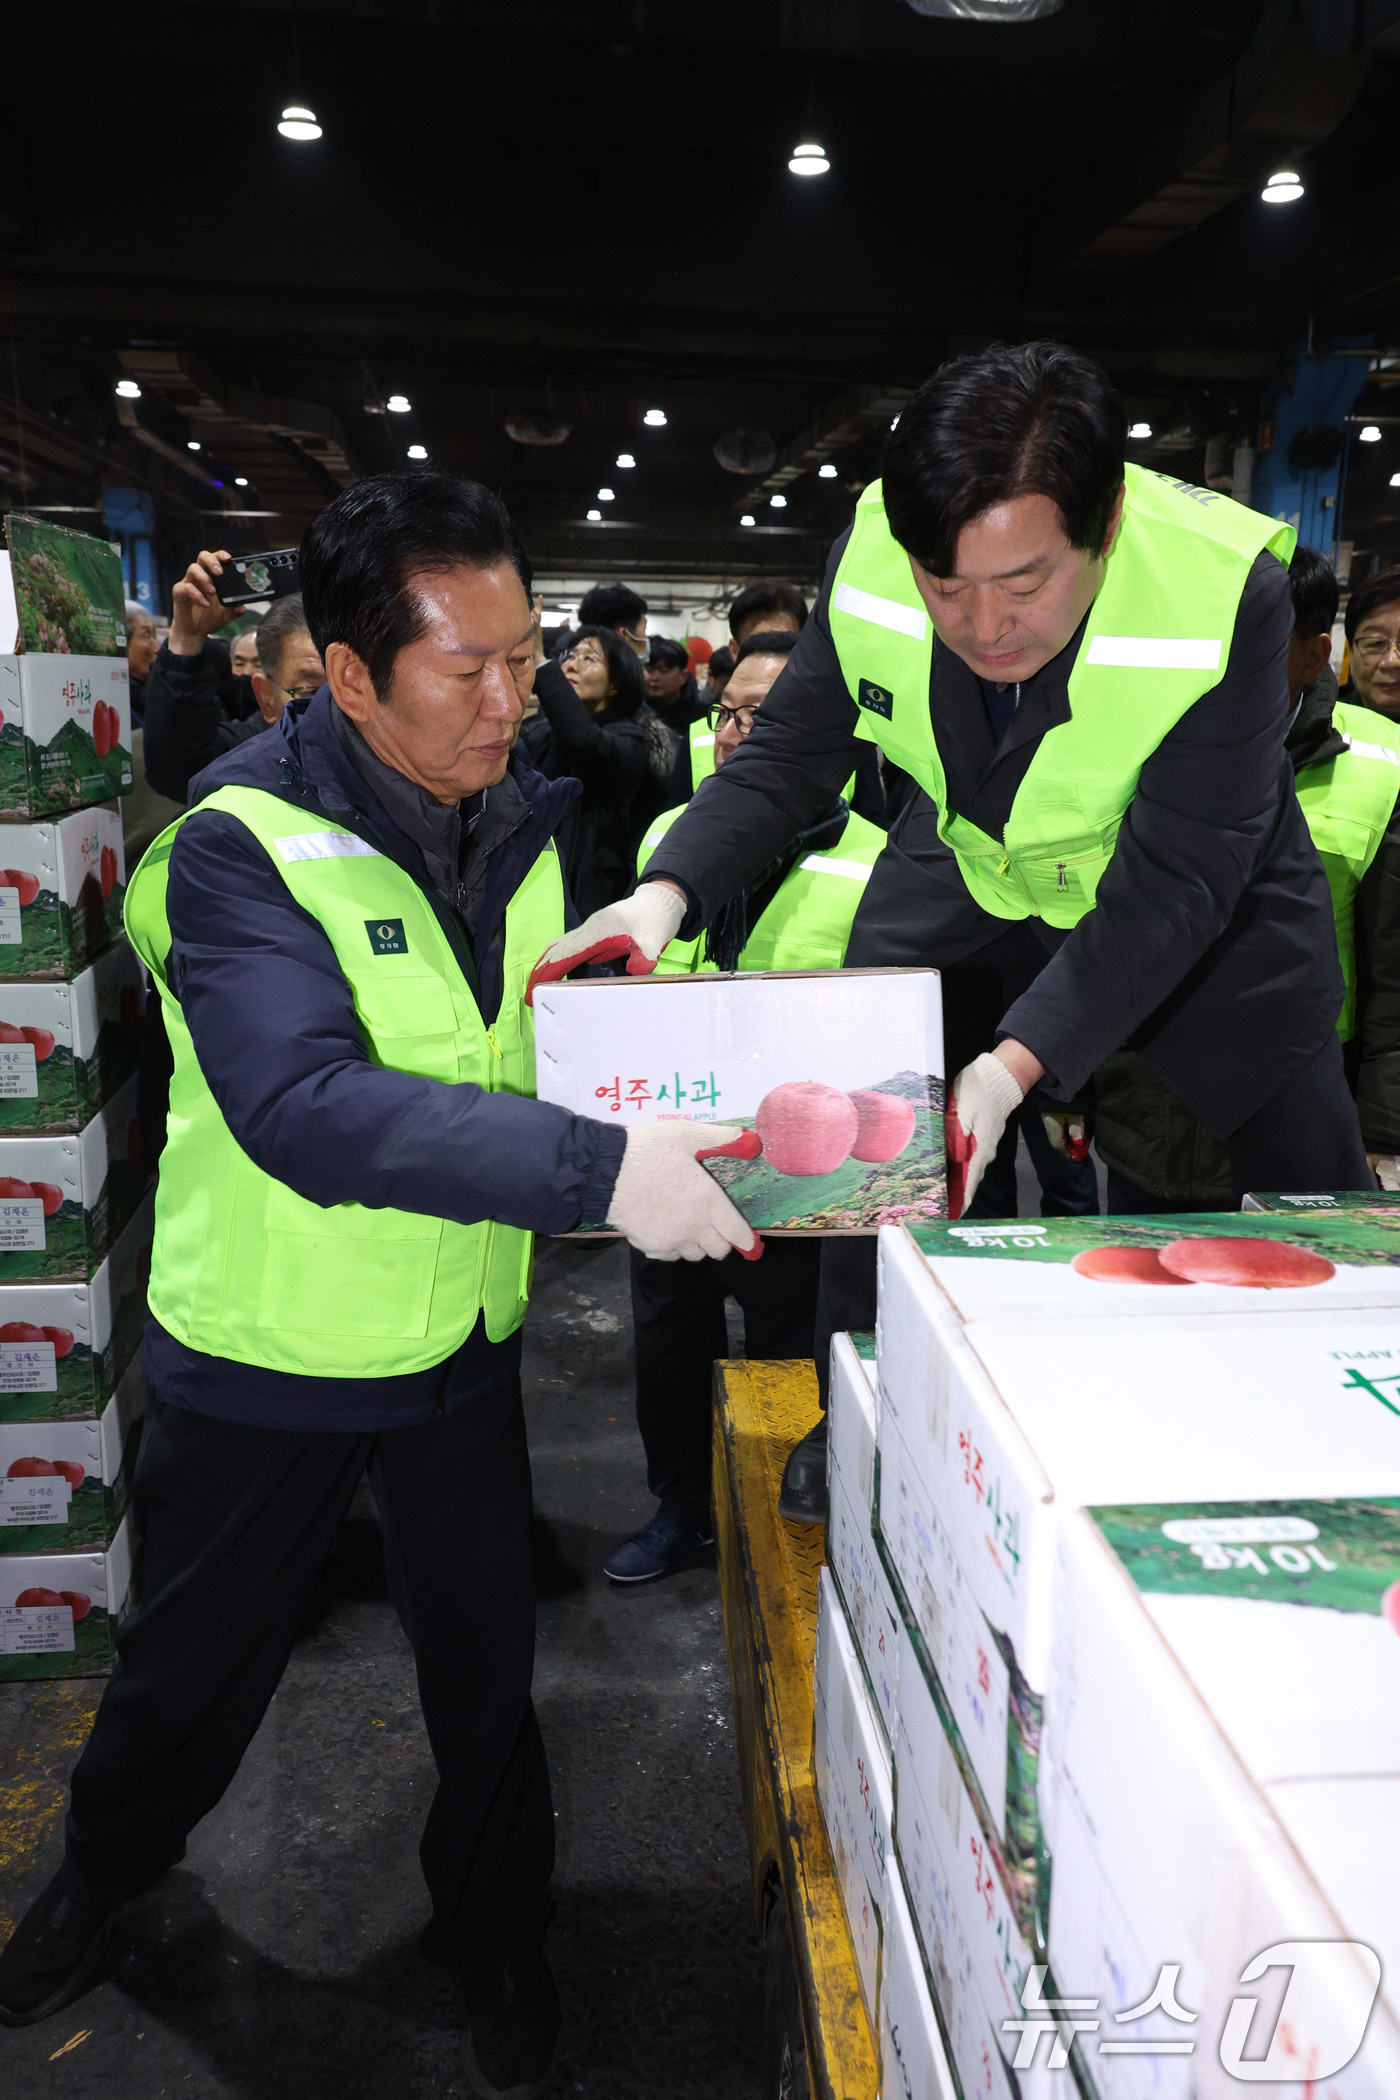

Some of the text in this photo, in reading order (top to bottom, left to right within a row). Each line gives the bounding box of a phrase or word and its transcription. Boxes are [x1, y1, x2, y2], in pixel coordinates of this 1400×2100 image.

[62, 678, 92, 707] 영주사과
[595, 1071, 721, 1112] 영주사과
[694, 1112, 717, 1121] APPLE
[958, 1428, 1020, 1576] 영주사과
[1190, 1542, 1339, 1577] 10 kg
